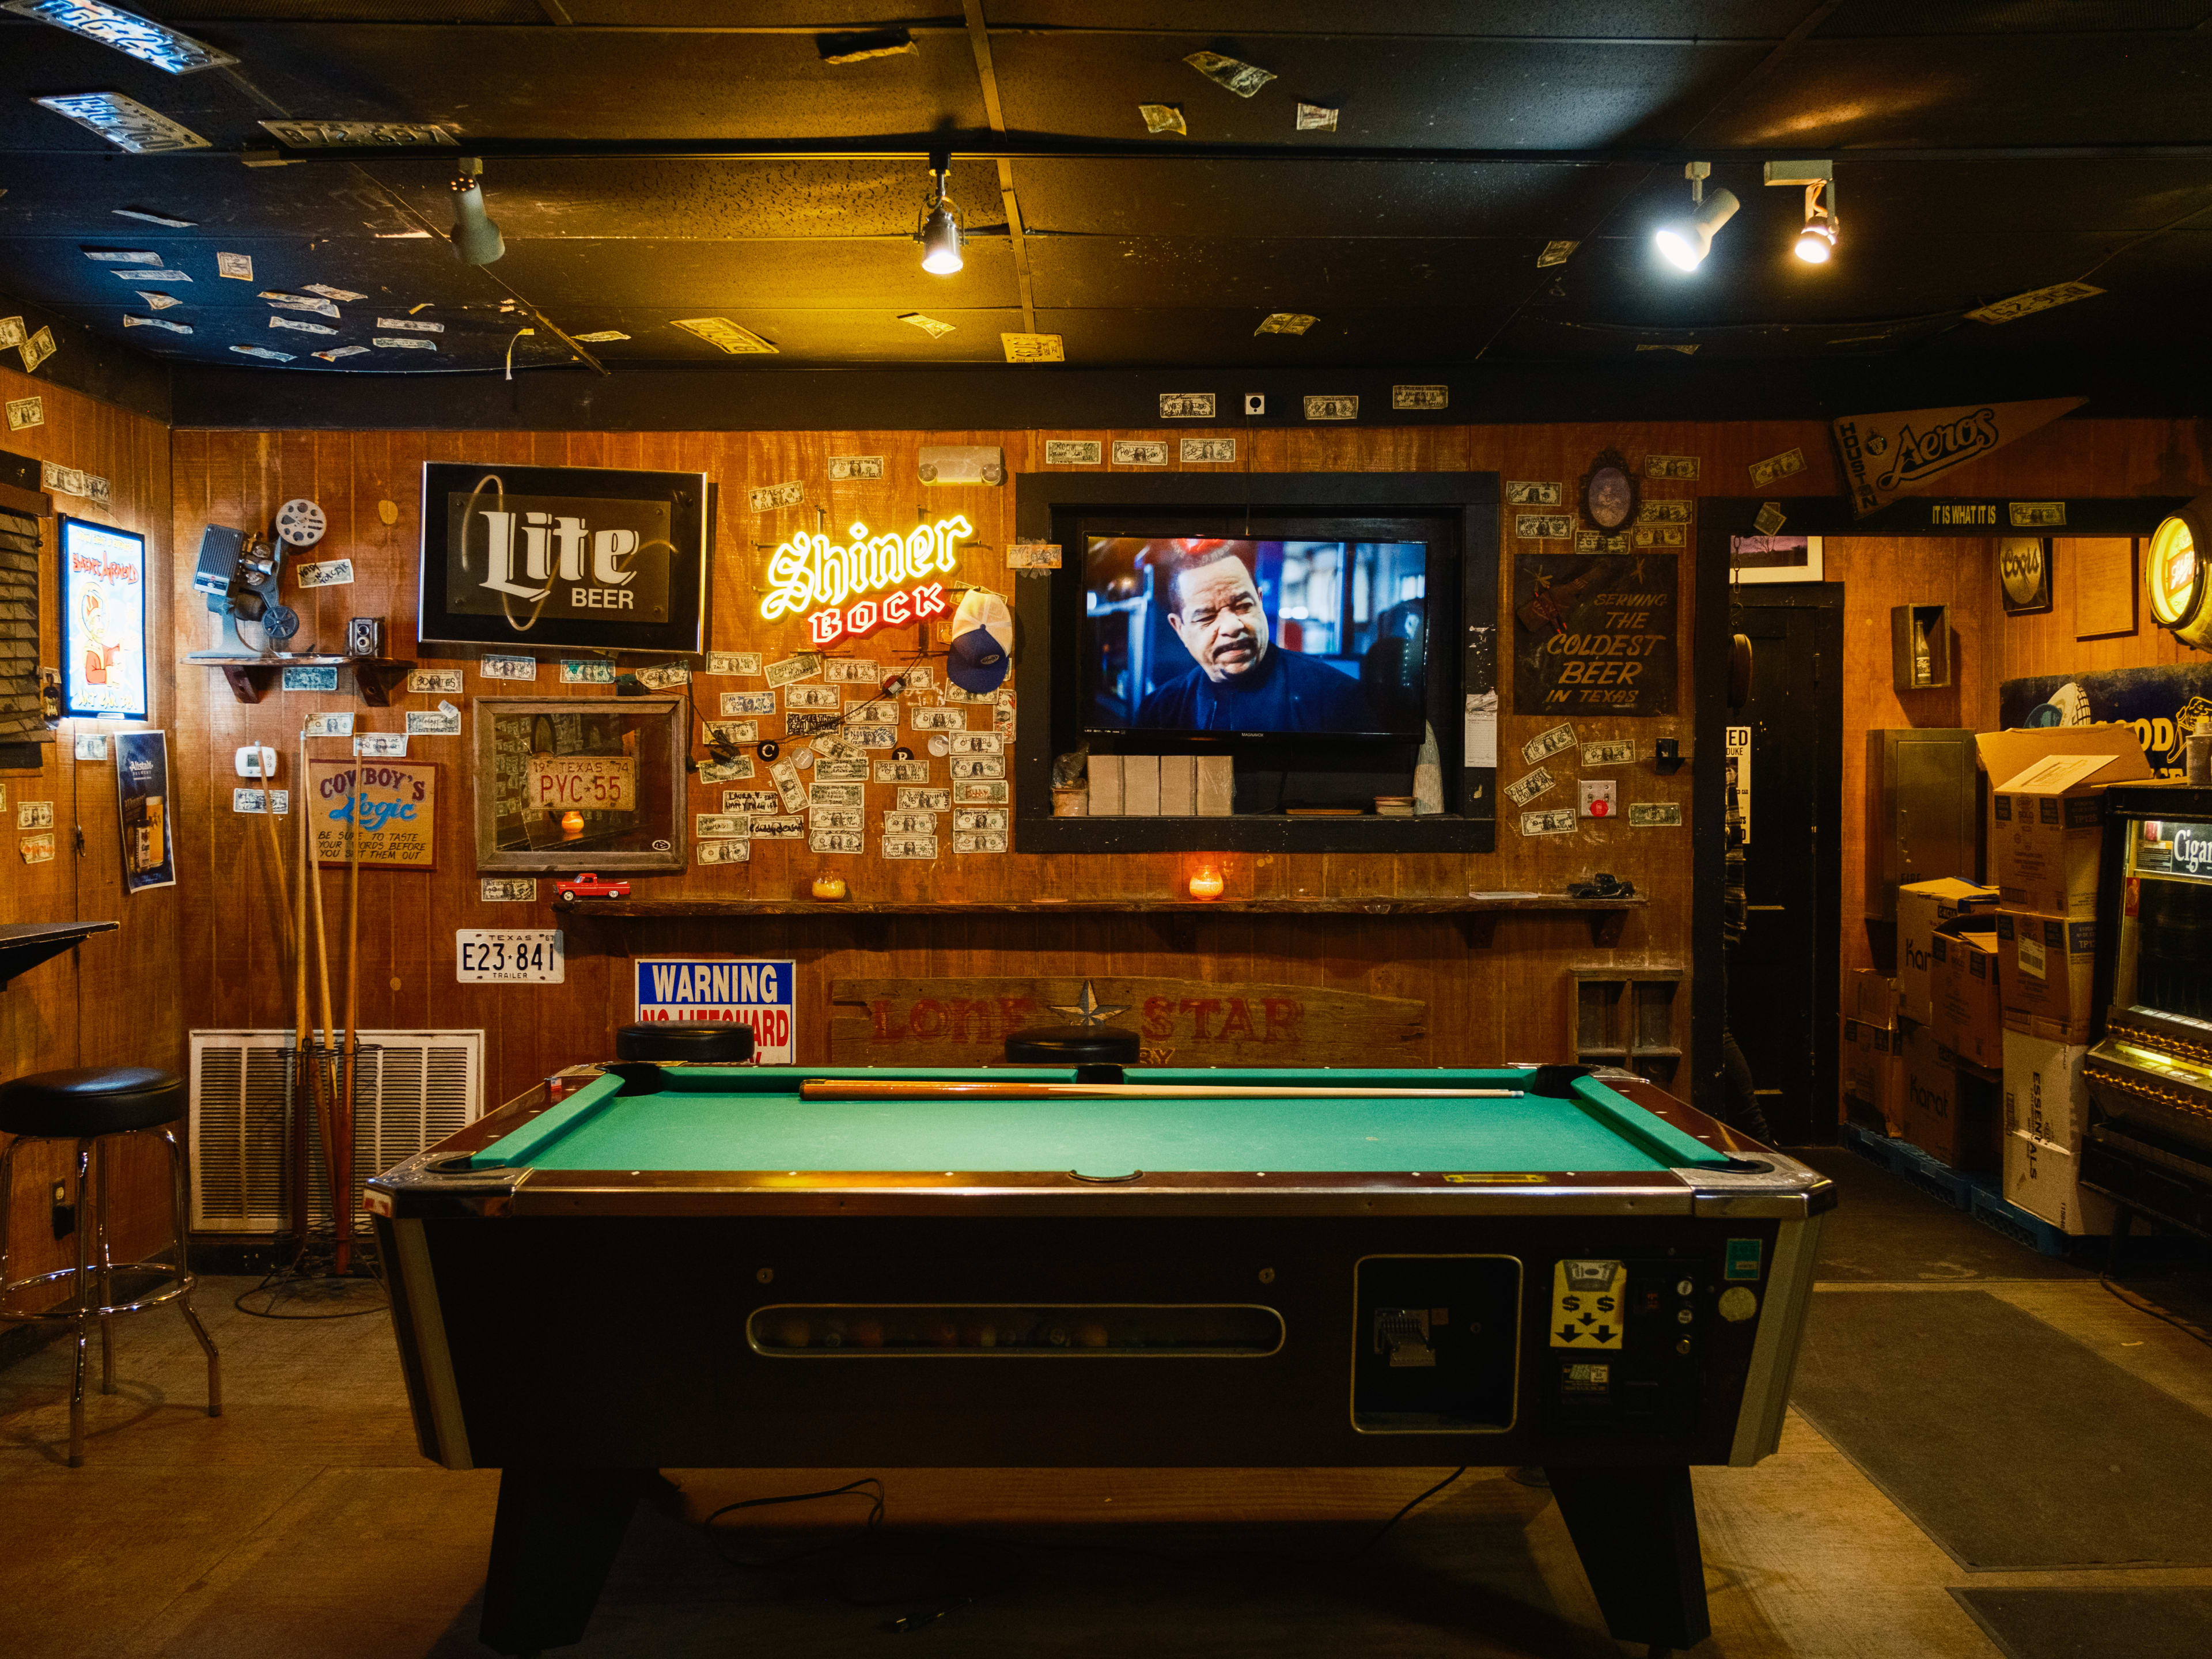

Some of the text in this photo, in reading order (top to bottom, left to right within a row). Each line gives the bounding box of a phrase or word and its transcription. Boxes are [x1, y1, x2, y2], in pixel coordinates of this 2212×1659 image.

[1876, 408, 1999, 491] Aeros
[1933, 506, 1996, 524] IT IS WHAT IT IS
[72, 551, 139, 586] SAINT ARNOLD
[478, 511, 639, 603] Lite
[761, 515, 973, 620] Shiner
[2002, 547, 2041, 579] Coors
[571, 588, 634, 609] BEER
[1594, 593, 1668, 607] SERVING
[808, 582, 946, 643] BOCK
[1605, 612, 1650, 628] THE
[1547, 634, 1666, 656] COLDEST
[1558, 661, 1642, 684] BEER
[1545, 690, 1639, 703] IN TEXAS
[762, 744, 775, 757] C
[794, 750, 811, 766] H
[934, 739, 944, 753] S
[534, 762, 629, 773] 19 TEXAS 74
[320, 767, 426, 801] COWBOY'S
[540, 775, 622, 802] PYC 55
[329, 793, 418, 831] Logic
[318, 831, 332, 839] BE
[372, 833, 384, 841] TO
[389, 833, 419, 842] TASTE
[352, 842, 384, 850] ORDS
[388, 843, 426, 851] BEFORE
[320, 850, 422, 860] YOU ST THEM OUT
[463, 943, 554, 971] E23 841
[1906, 938, 1931, 972] Kar
[652, 964, 778, 1003] WARNING
[1141, 997, 1304, 1044] STAR
[1909, 1073, 1949, 1119] Karat
[2029, 1071, 2041, 1180] ESSENTALS
